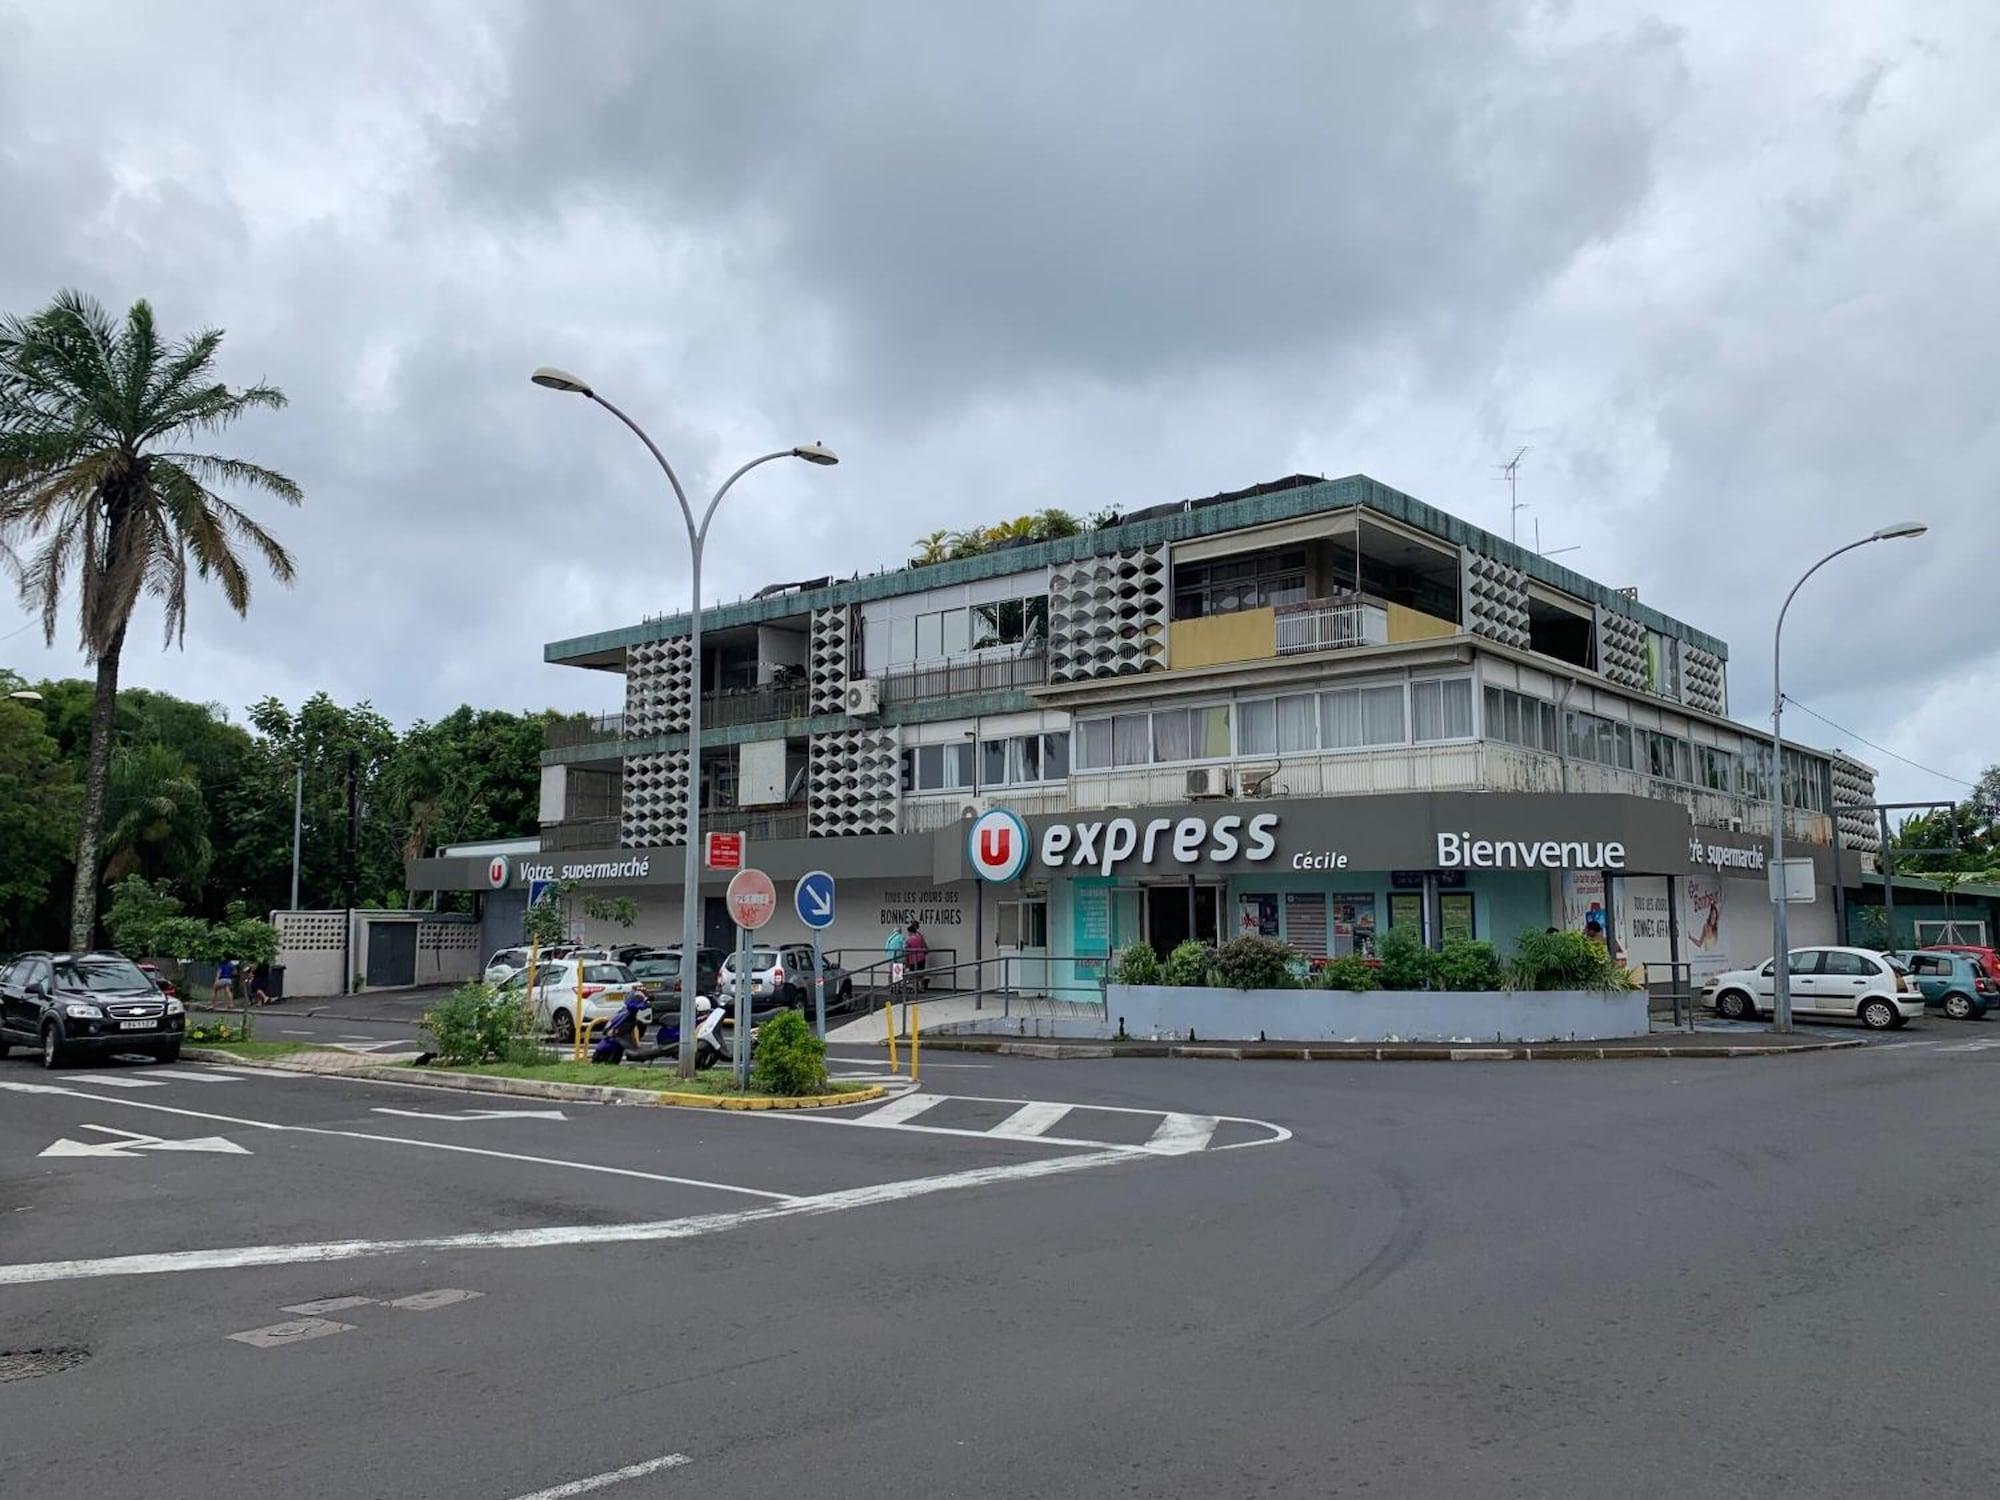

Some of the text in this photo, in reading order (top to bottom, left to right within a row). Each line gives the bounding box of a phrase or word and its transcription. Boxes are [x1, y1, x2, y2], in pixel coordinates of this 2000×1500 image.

[980, 813, 1279, 877] U express
[1437, 831, 1625, 869] Bienvenue
[520, 856, 649, 881] Votre supermarché
[1292, 850, 1348, 871] Cécile
[1707, 844, 1764, 872] supermarché
[884, 891, 960, 904] TOUS LES JOURS DES
[880, 909, 963, 926] BONNES AFFAIRES
